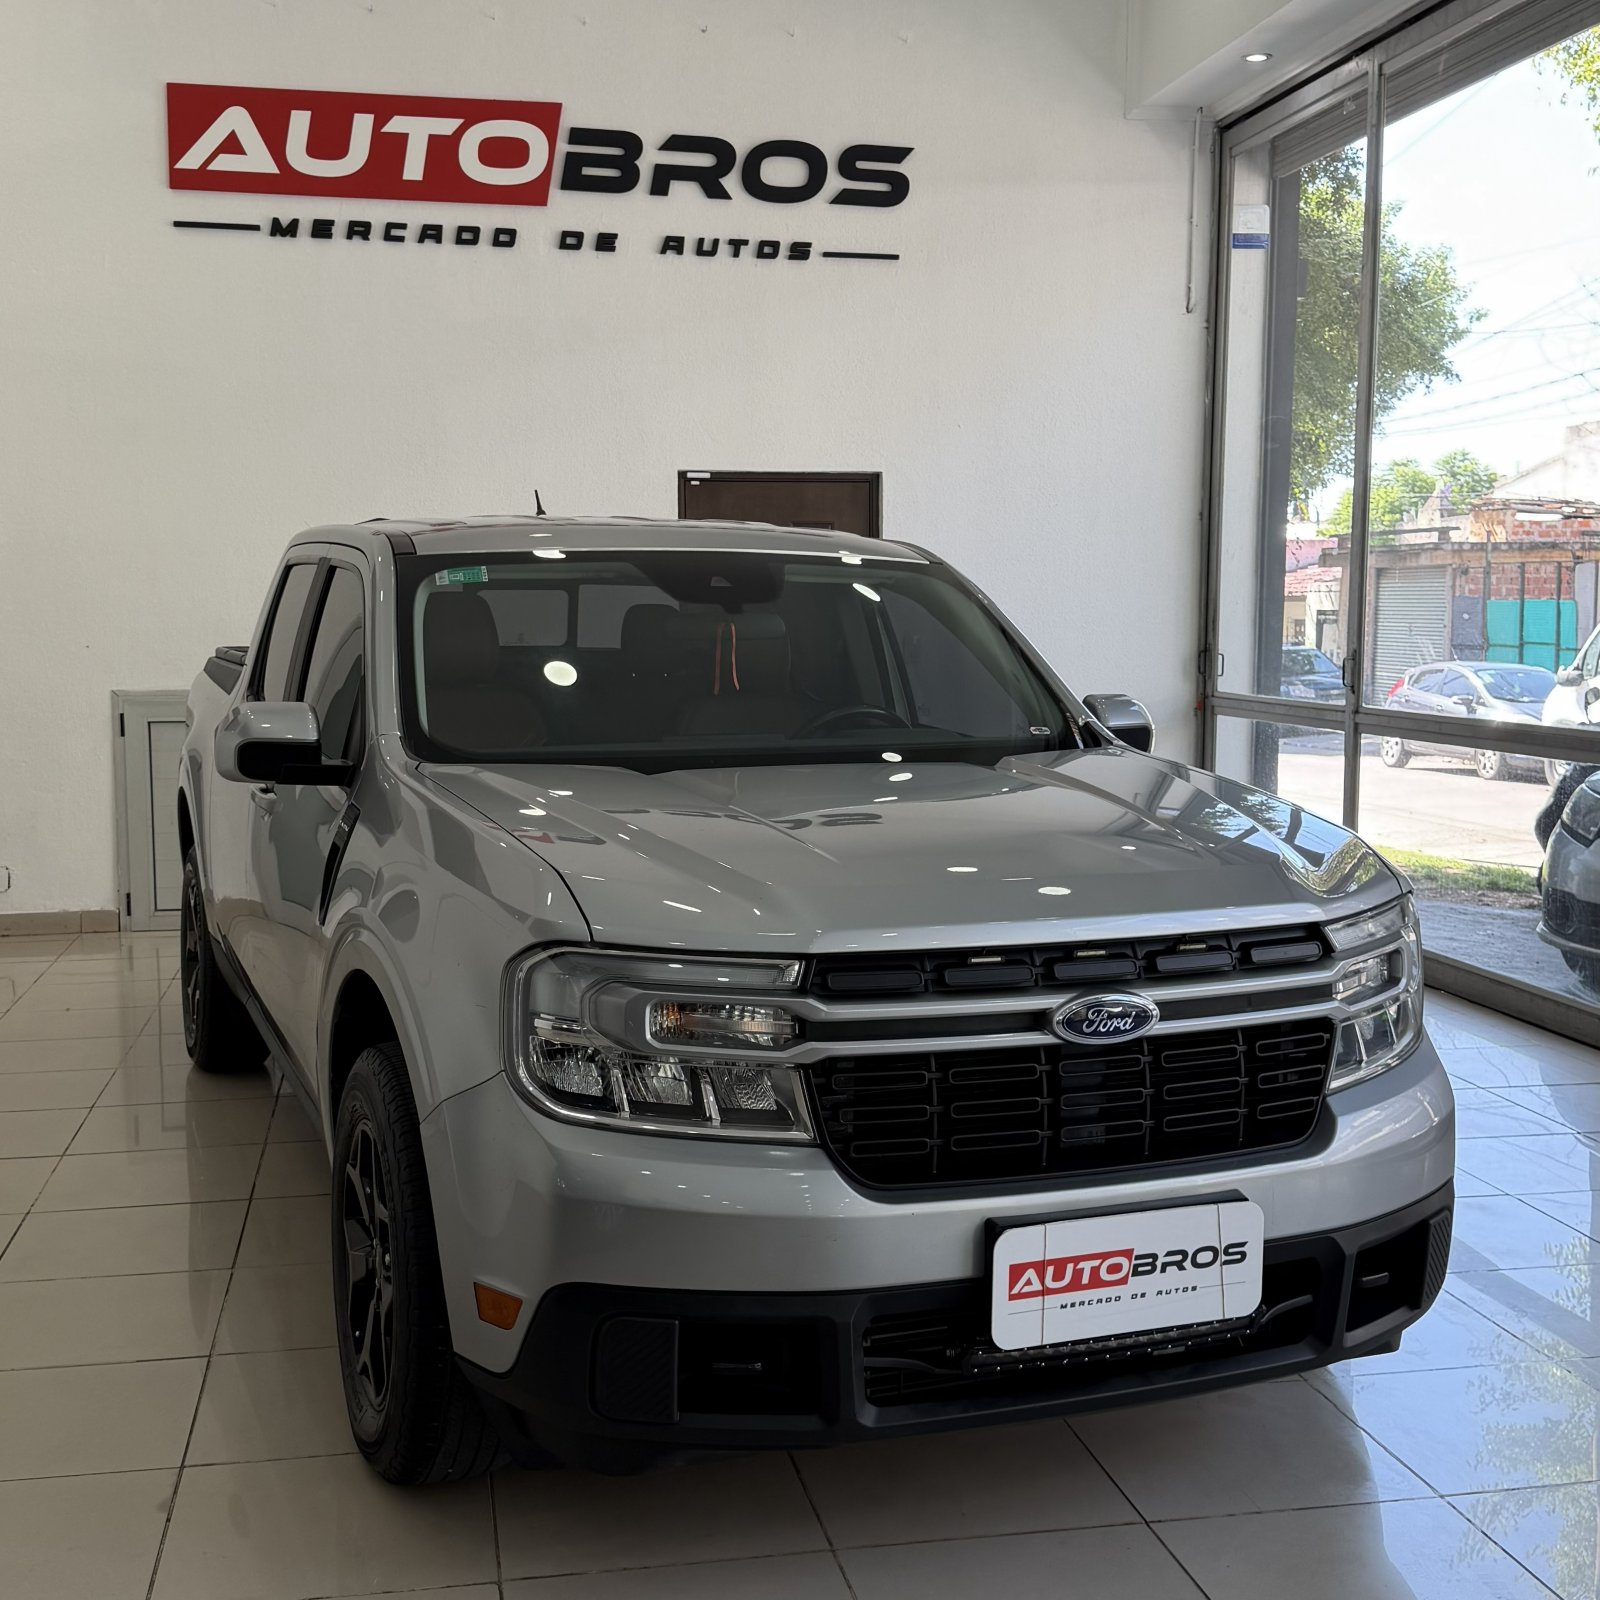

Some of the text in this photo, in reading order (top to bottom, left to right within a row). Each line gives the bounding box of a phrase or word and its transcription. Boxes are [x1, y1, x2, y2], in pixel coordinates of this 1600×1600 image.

[172, 104, 915, 208] AUTOBROS
[269, 216, 813, 261] MERCADO DE AUTOS
[1082, 1006, 1136, 1034] Ford
[1009, 1240, 1249, 1295] AUTOBROS
[1059, 1285, 1199, 1310] MERCADO DE AUTOS
